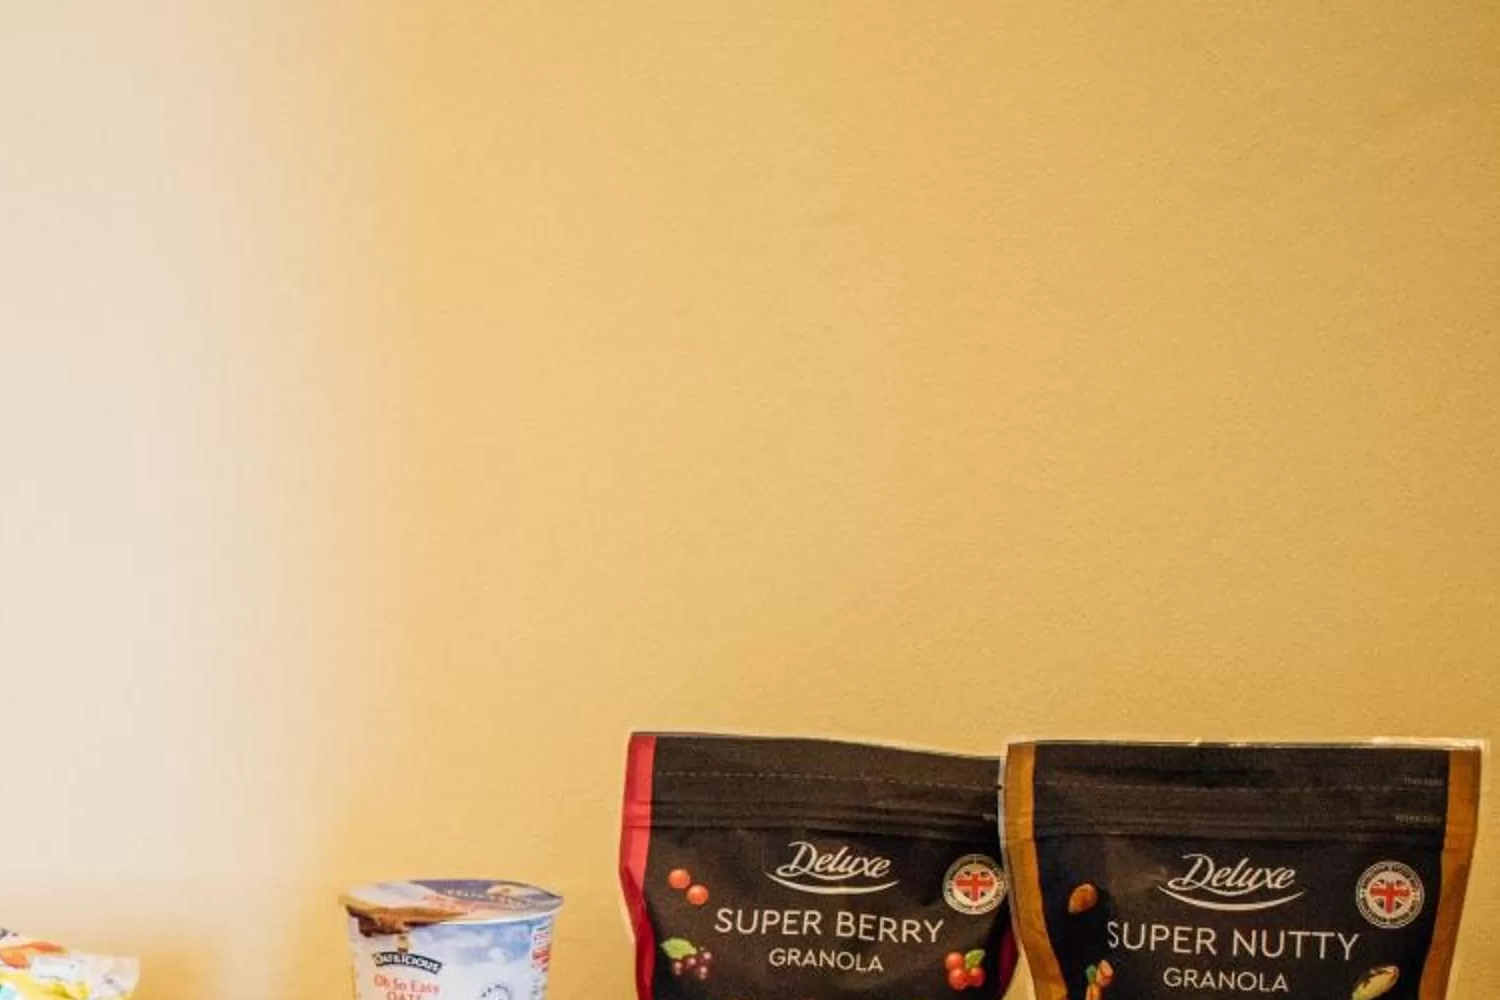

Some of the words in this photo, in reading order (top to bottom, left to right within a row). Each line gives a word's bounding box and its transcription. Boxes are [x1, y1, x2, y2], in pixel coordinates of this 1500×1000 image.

[776, 841, 891, 880] Deluxe
[1167, 852, 1297, 893] Deluxe
[714, 906, 822, 936] SUPER
[835, 911, 945, 943] BERRY
[1106, 920, 1216, 956] SUPER
[1232, 929, 1360, 961] NUTTY
[768, 947, 884, 972] GRANOLA
[1162, 966, 1289, 993] GRANOLA
